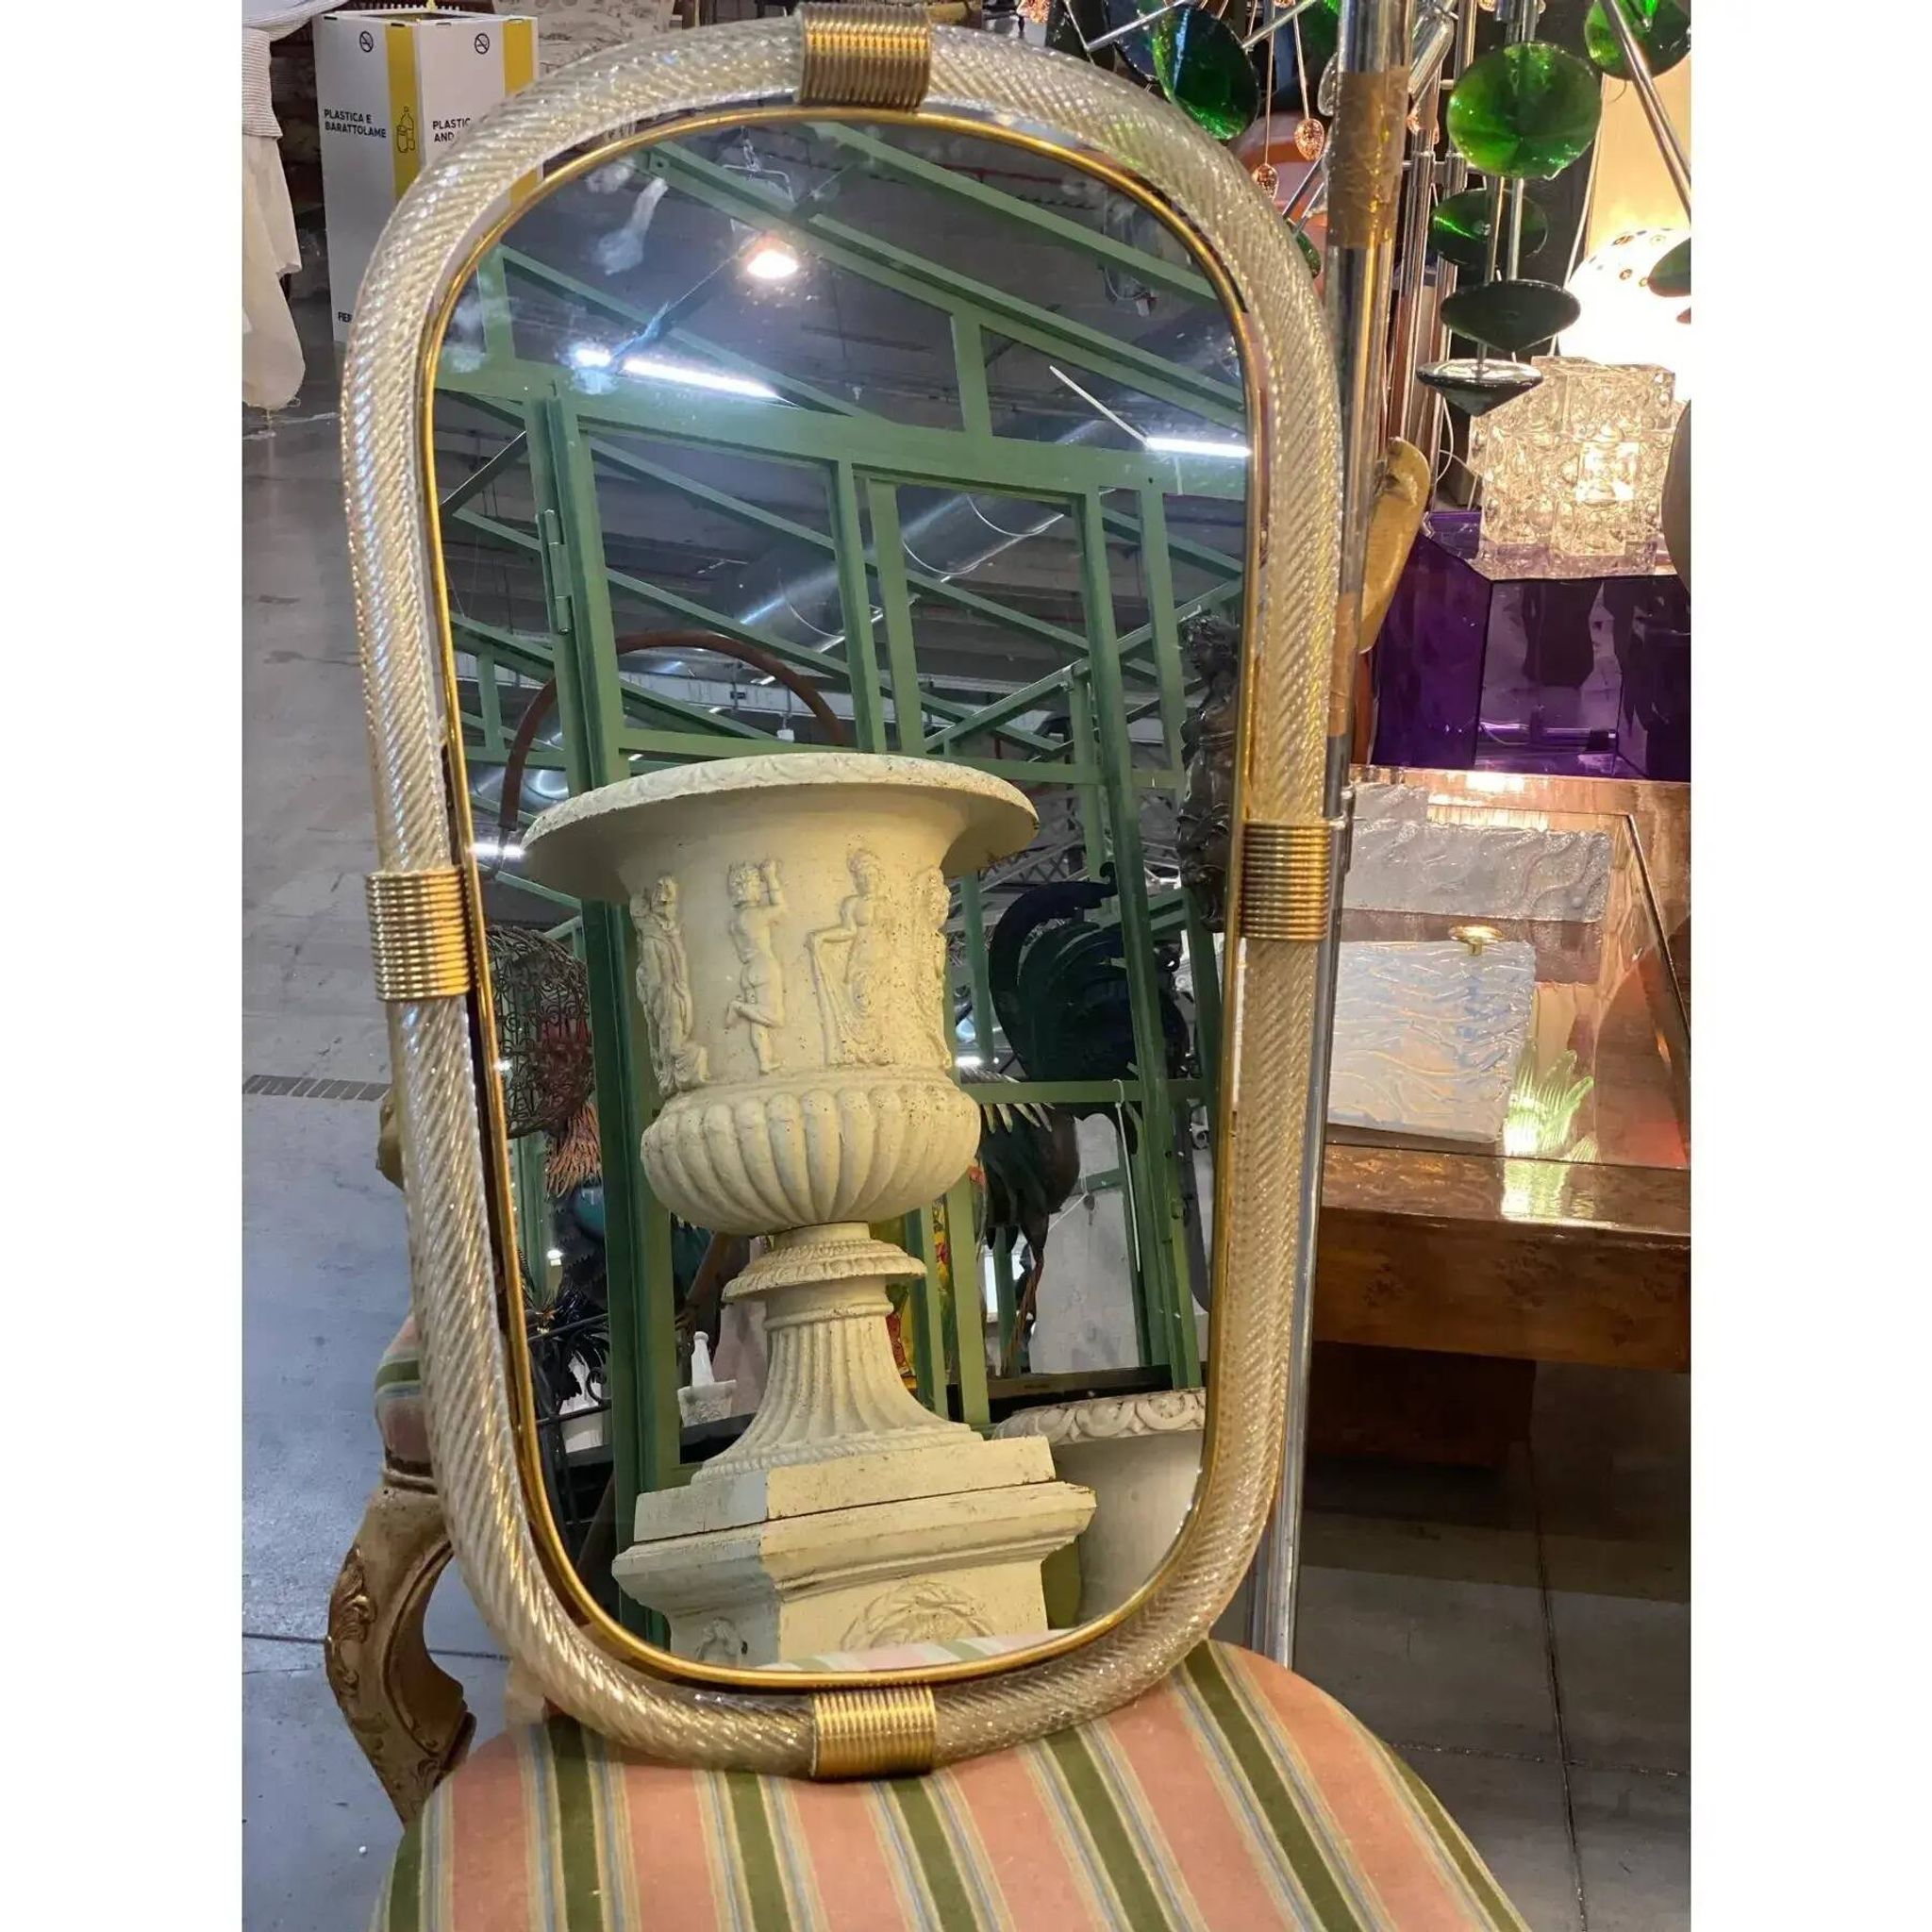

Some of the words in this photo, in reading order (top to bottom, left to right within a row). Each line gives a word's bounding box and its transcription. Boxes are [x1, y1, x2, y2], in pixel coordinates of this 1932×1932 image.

[324, 108, 364, 123] PLASTICA
[366, 113, 373, 124] E
[325, 121, 387, 139] BARATTOLAME
[432, 117, 471, 130] PLASTIC
[434, 131, 455, 142] AND
